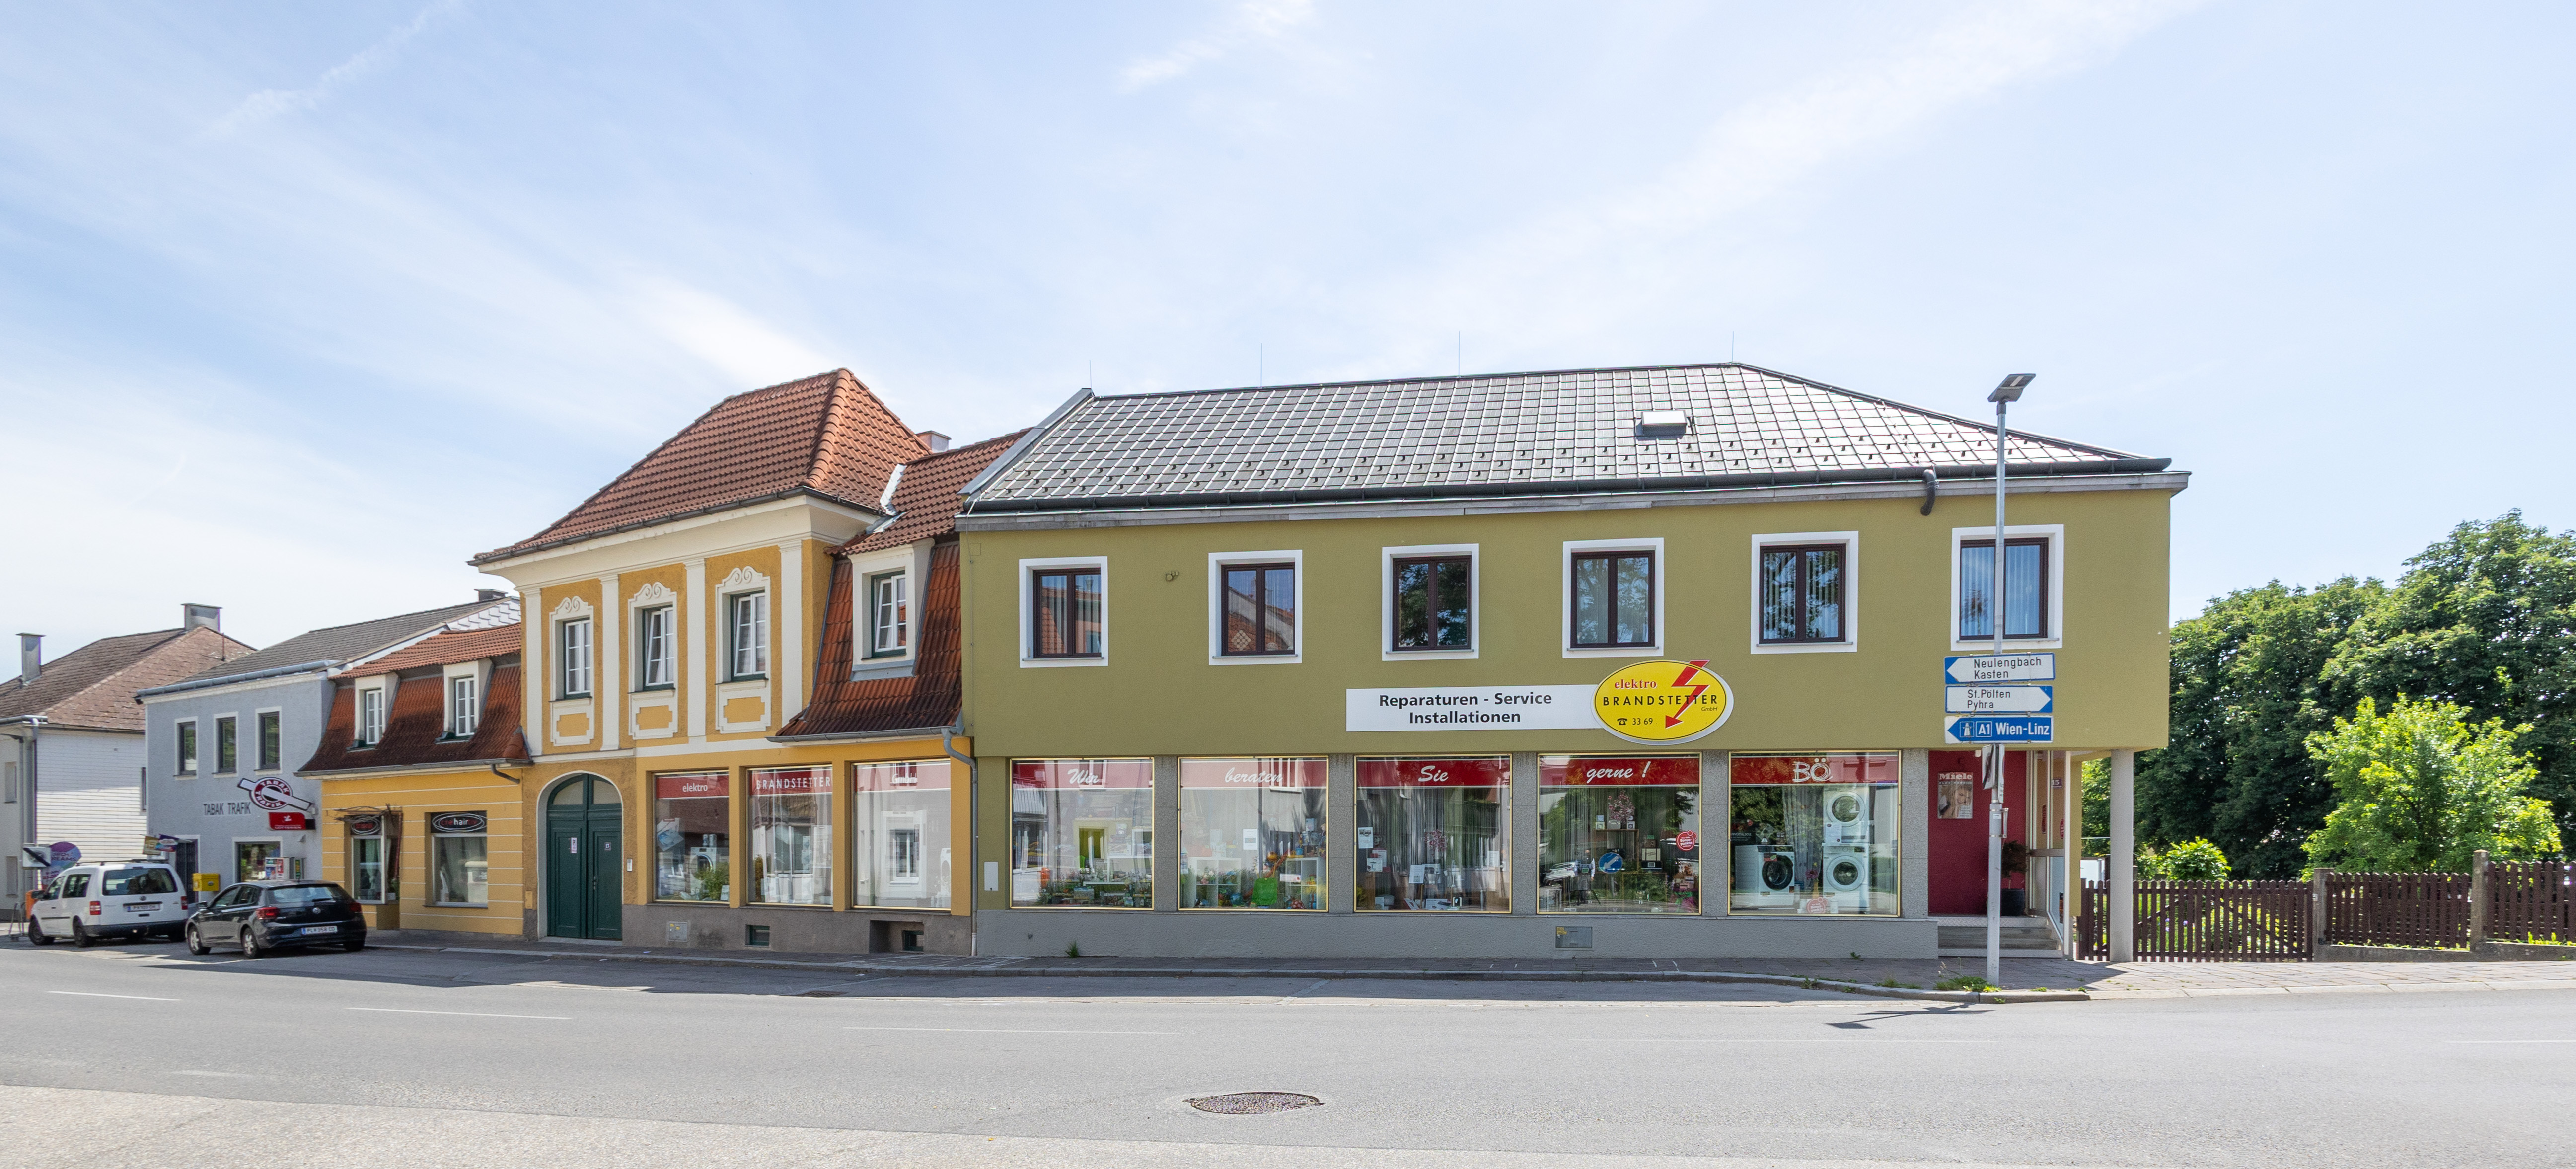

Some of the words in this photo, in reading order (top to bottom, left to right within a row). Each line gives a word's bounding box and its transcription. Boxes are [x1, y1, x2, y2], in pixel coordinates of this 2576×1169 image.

[1974, 657, 2042, 669] Neulengbach
[1974, 670, 2009, 679] Kasten
[1615, 679, 1657, 689] elektro
[1379, 694, 1479, 709] Reparaturen
[1494, 691, 1552, 705] Service
[1603, 695, 1717, 706] BRANDSTETTER
[1967, 700, 1994, 710] Pyhra
[1409, 710, 1521, 724] Installationen
[1978, 723, 1990, 735] A1
[1995, 722, 2050, 735] Wien-Linz
[1067, 768, 1100, 785] Wir
[1224, 767, 1283, 784] beraten
[1417, 765, 1449, 783] Sie
[1586, 766, 1634, 784] gerne
[260, 779, 290, 793] TABAK
[682, 782, 708, 793] elektro
[755, 776, 831, 790] BRANDSTETTER
[255, 790, 284, 807] TRAFIK
[203, 803, 224, 815] TABAK
[227, 802, 251, 815] TRAFIK
